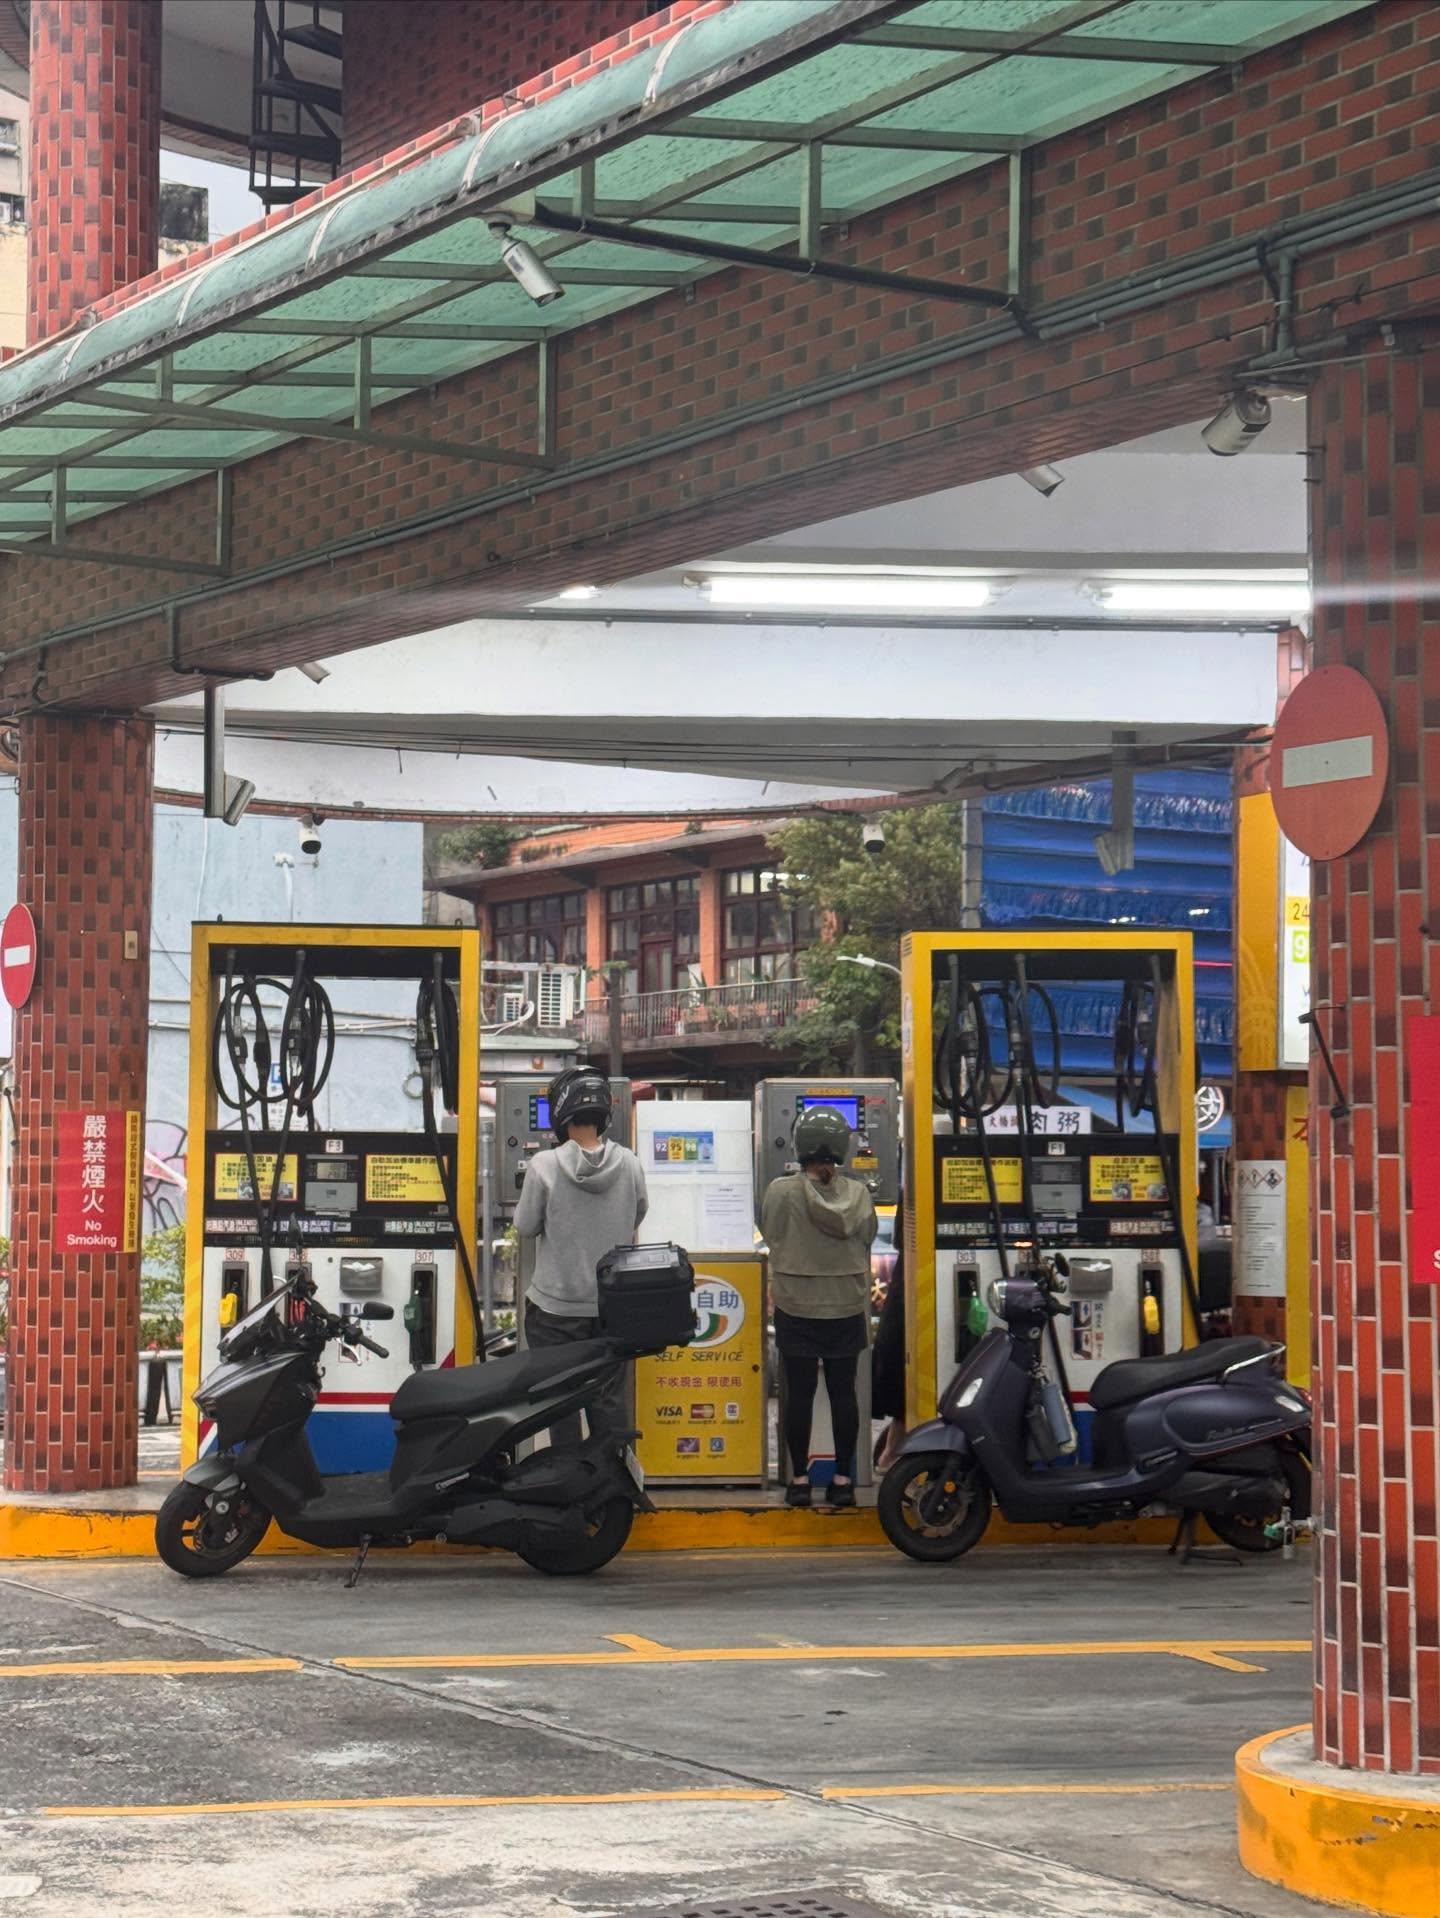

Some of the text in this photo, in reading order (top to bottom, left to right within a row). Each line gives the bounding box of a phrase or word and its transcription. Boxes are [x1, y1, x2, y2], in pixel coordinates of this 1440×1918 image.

[1031, 1111, 1080, 1134] 肉粥
[328, 1141, 341, 1151] F3
[656, 1143, 667, 1152] 92
[670, 1143, 682, 1152] 95
[685, 1143, 697, 1152] 98
[1050, 1143, 1062, 1153] F1
[82, 1115, 106, 1213] 嚴禁煙火
[85, 1220, 102, 1231] No
[67, 1234, 117, 1247] Smoking
[226, 1250, 245, 1260] 309
[416, 1251, 432, 1261] 307
[697, 1290, 739, 1308] 自助
[655, 1351, 744, 1362] SELF SERVICE
[656, 1406, 683, 1417] VISA
